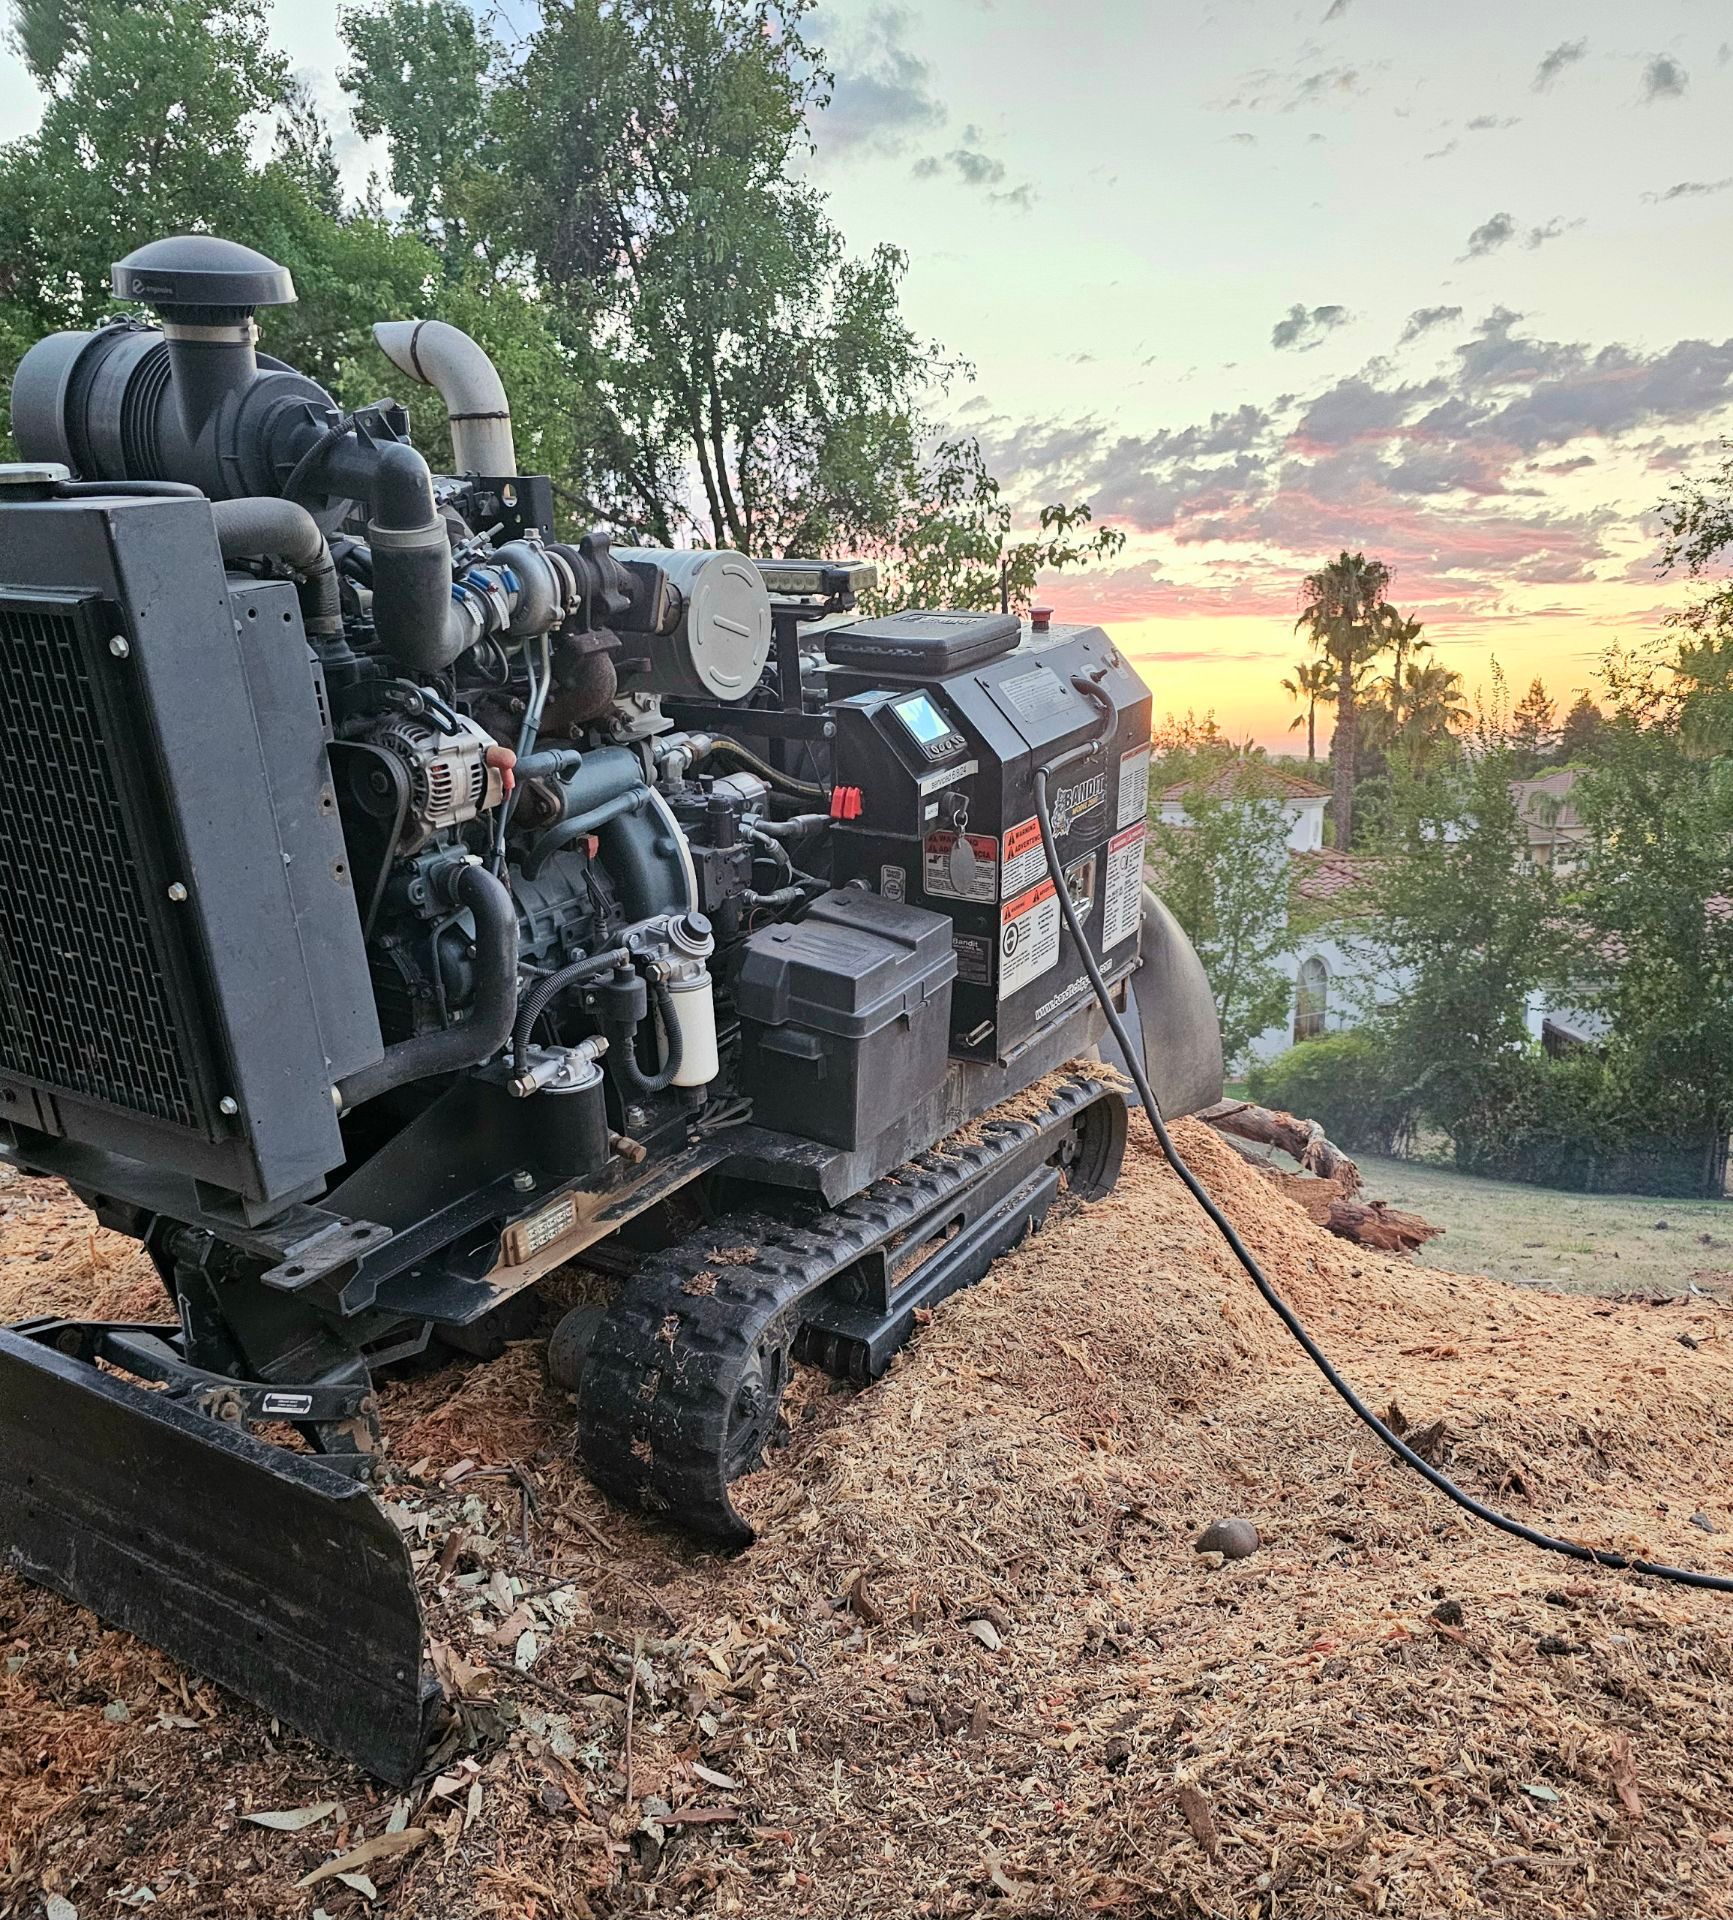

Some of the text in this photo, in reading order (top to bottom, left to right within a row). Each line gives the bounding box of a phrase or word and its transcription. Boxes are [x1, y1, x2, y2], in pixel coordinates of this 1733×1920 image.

[1065, 773, 1106, 809] BANDIT
[1015, 823, 1036, 838] WARNING
[952, 937, 979, 948] Bandit
